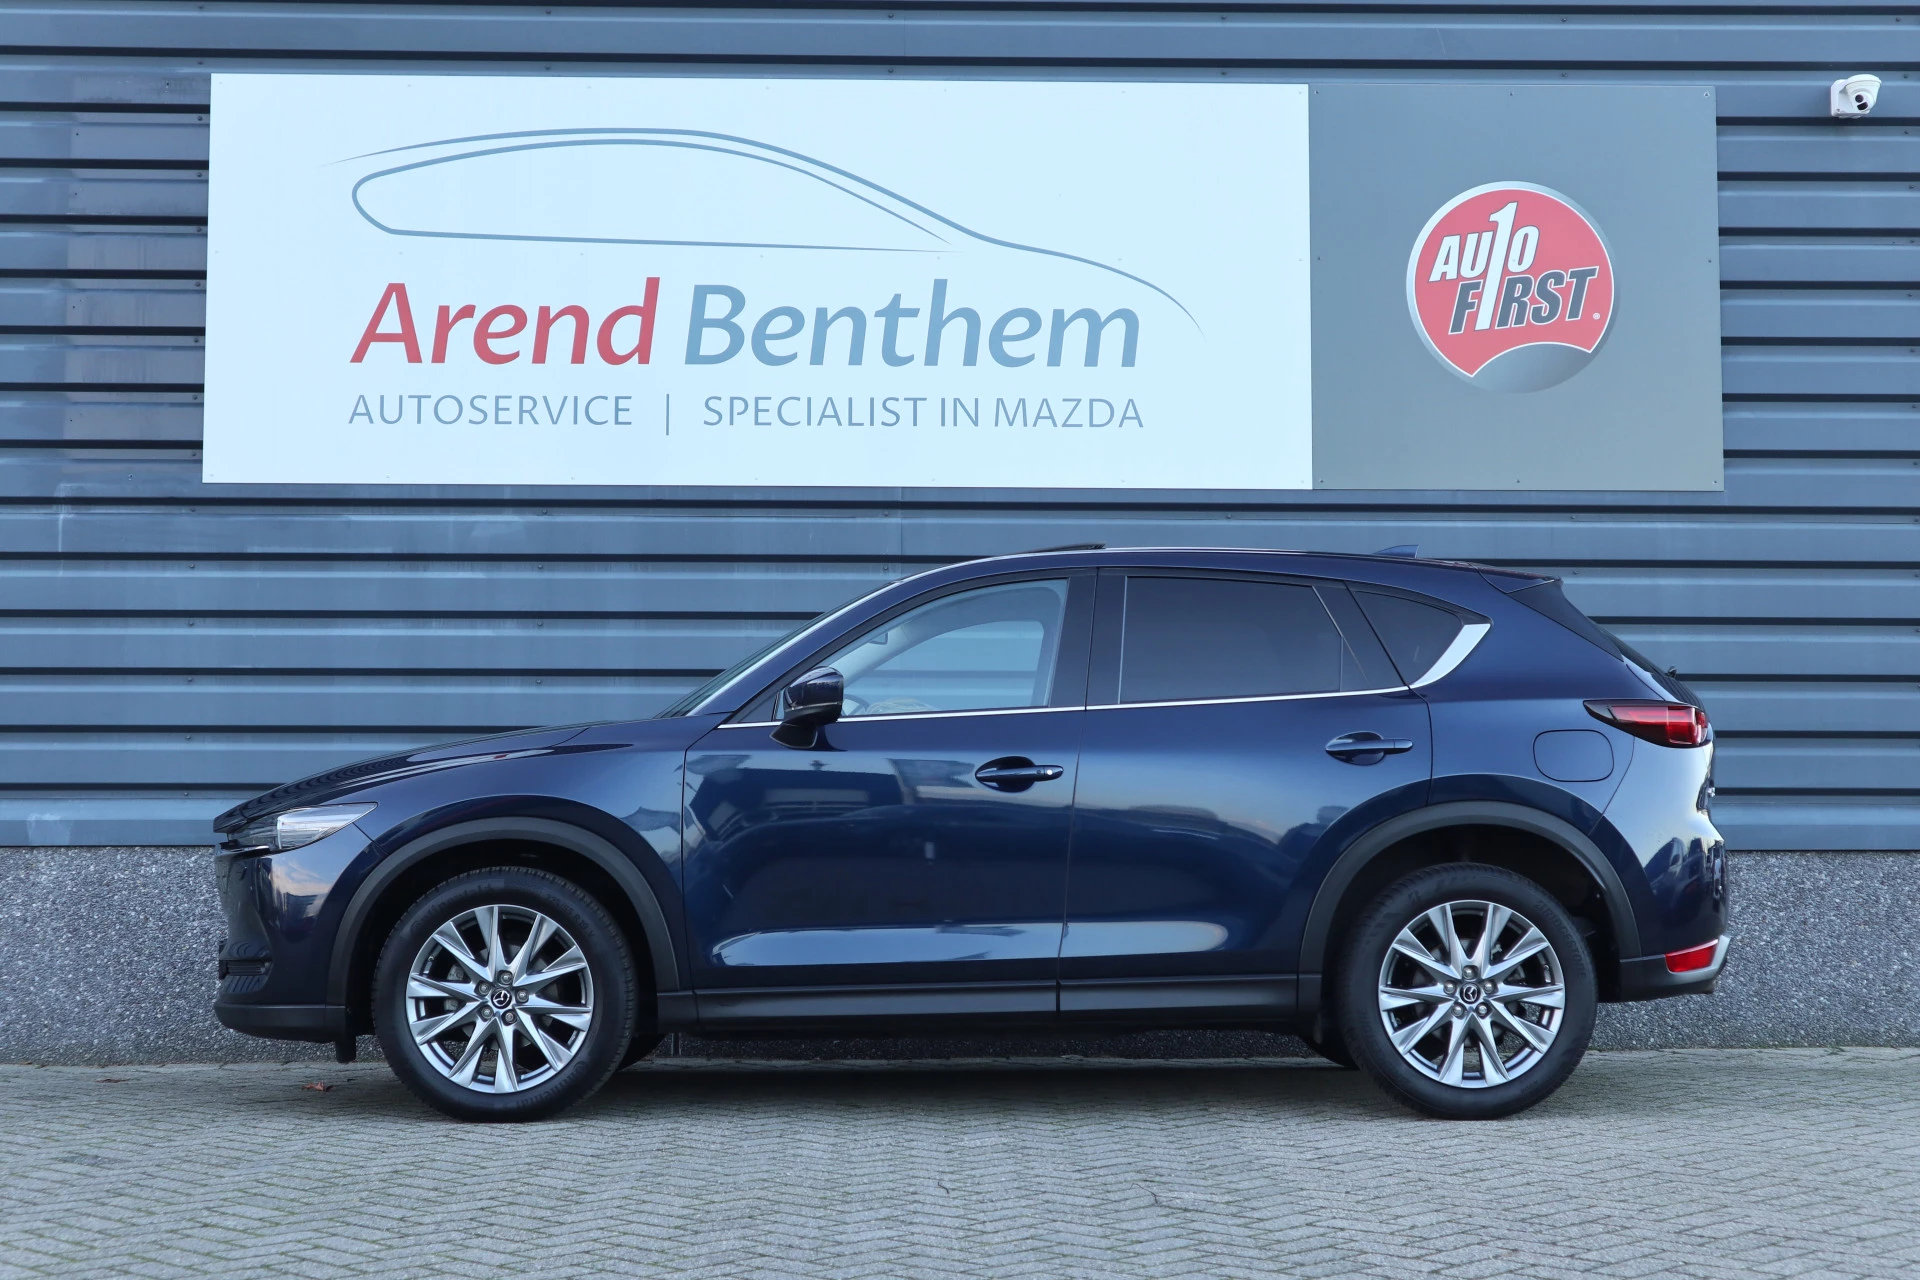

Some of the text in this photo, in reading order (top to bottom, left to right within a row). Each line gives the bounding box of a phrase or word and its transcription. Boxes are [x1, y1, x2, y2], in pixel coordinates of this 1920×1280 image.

[350, 277, 1140, 368] Arend Benthem
[348, 394, 1144, 428] AUTOSERVICE SPECIALIST IN MAZDA
